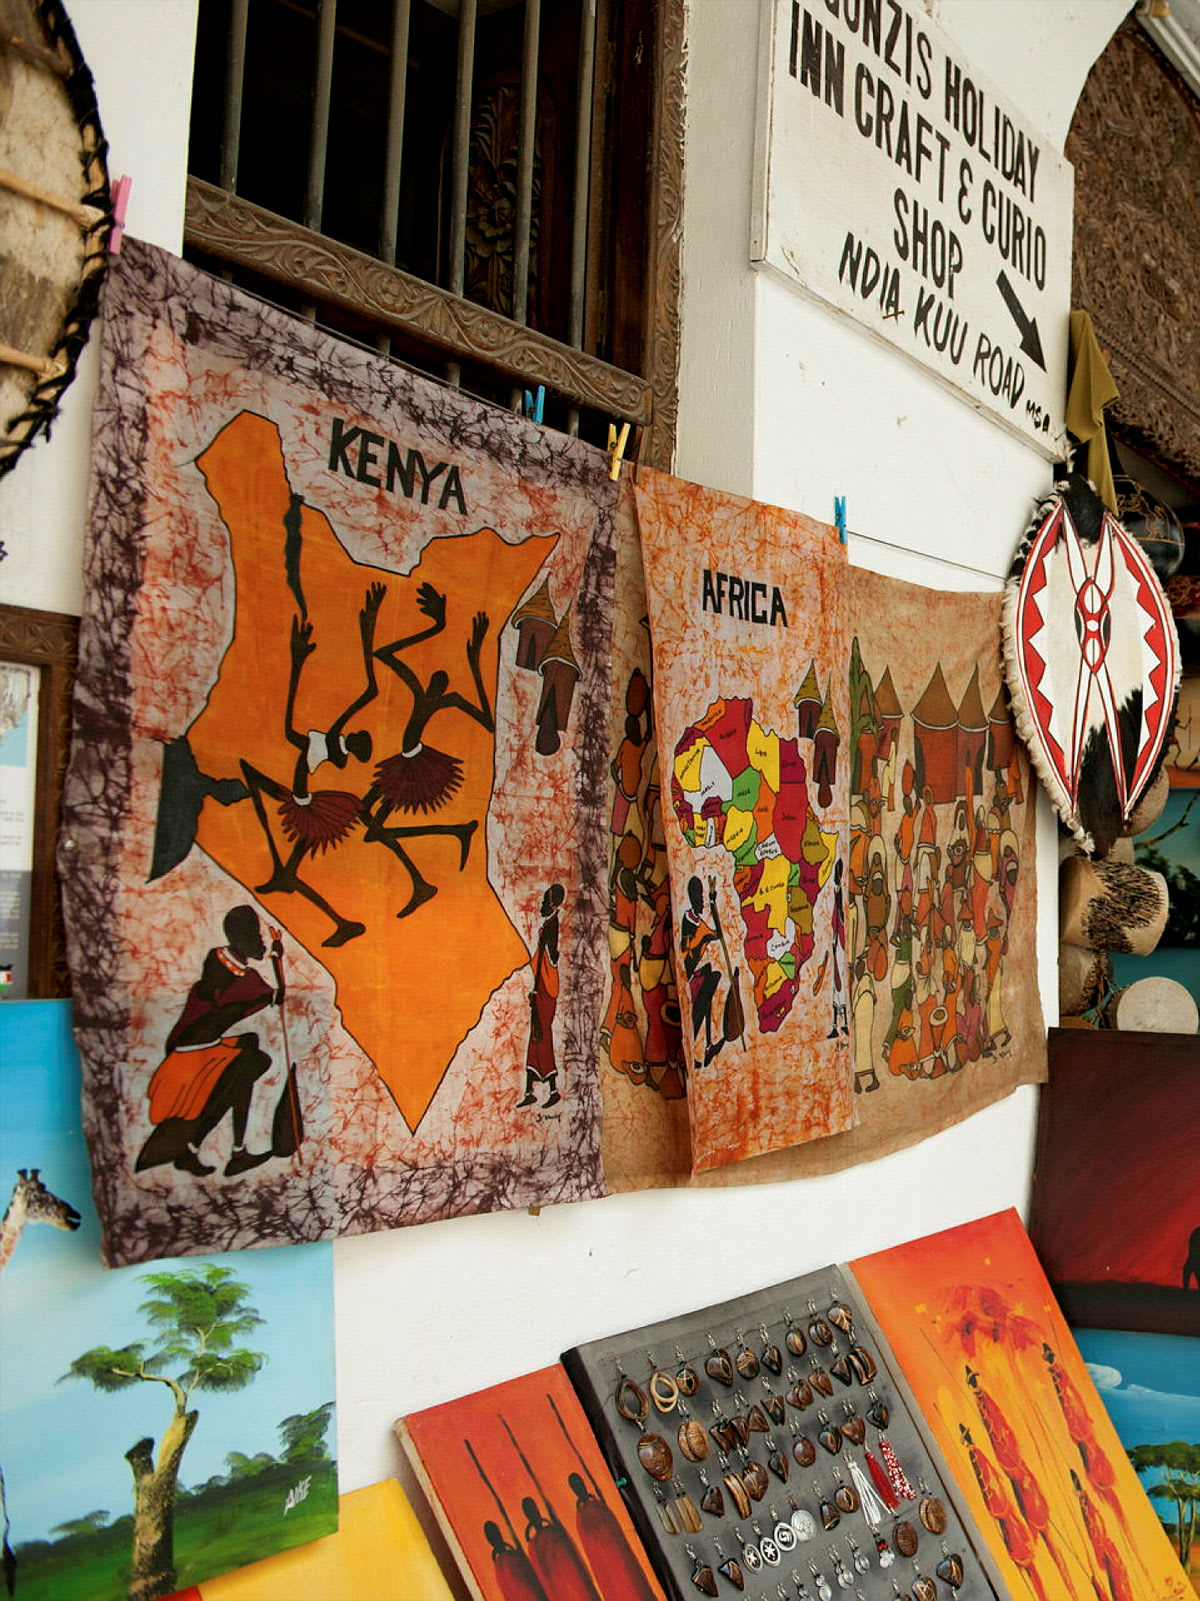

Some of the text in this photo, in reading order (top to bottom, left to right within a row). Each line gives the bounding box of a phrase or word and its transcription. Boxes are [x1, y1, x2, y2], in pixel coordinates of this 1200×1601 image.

[789, 0, 845, 118] INN
[855, 62, 950, 203] CRAFT
[982, 179, 1046, 291] CURIO
[824, 0, 1040, 203] NZIS HOLIDAY
[893, 188, 963, 299] SHOP
[838, 231, 902, 323] NDIA
[914, 286, 968, 365] KUU
[973, 332, 1025, 409] ROAD
[328, 417, 468, 515] KENYA
[702, 569, 788, 628] AFRICA
